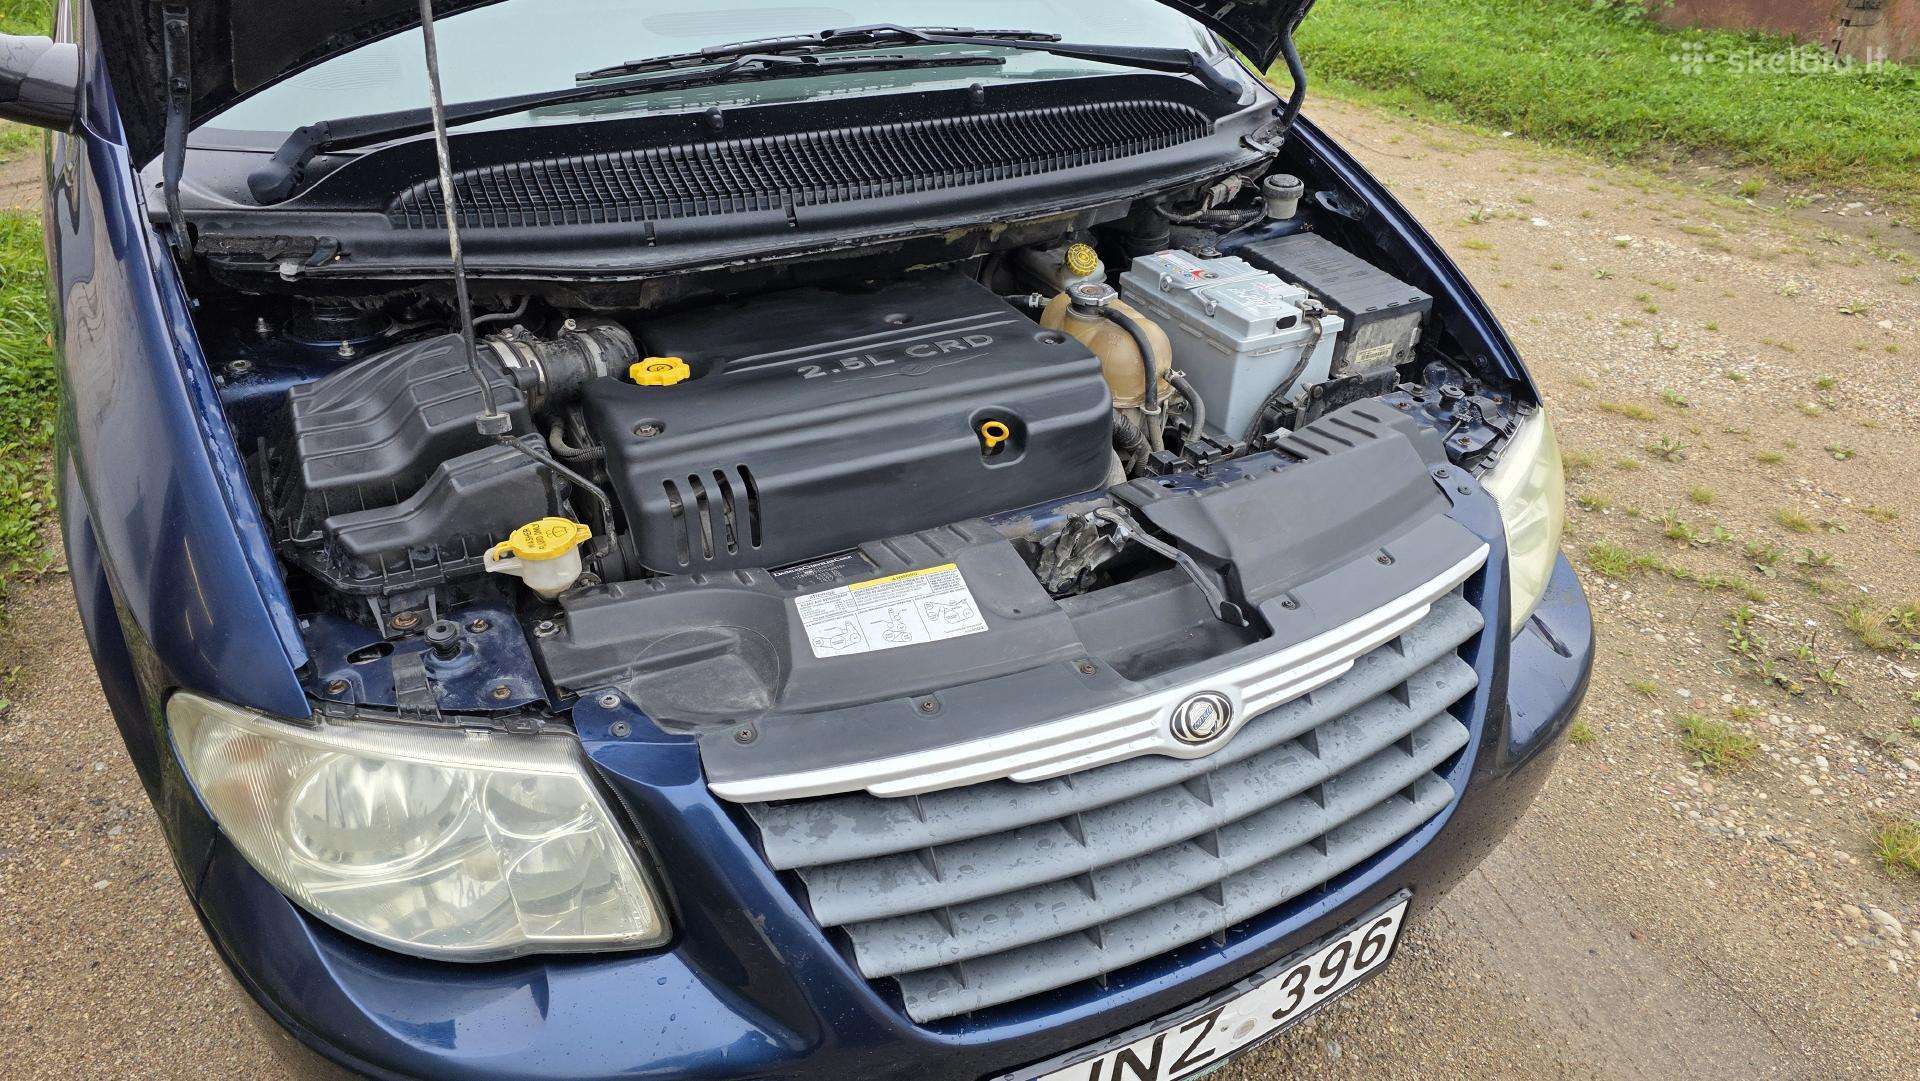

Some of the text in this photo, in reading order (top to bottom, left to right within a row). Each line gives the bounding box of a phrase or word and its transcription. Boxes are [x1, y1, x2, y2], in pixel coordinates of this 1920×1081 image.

[797, 334, 994, 380] 2.5L CRD
[1272, 916, 1392, 1020] 396
